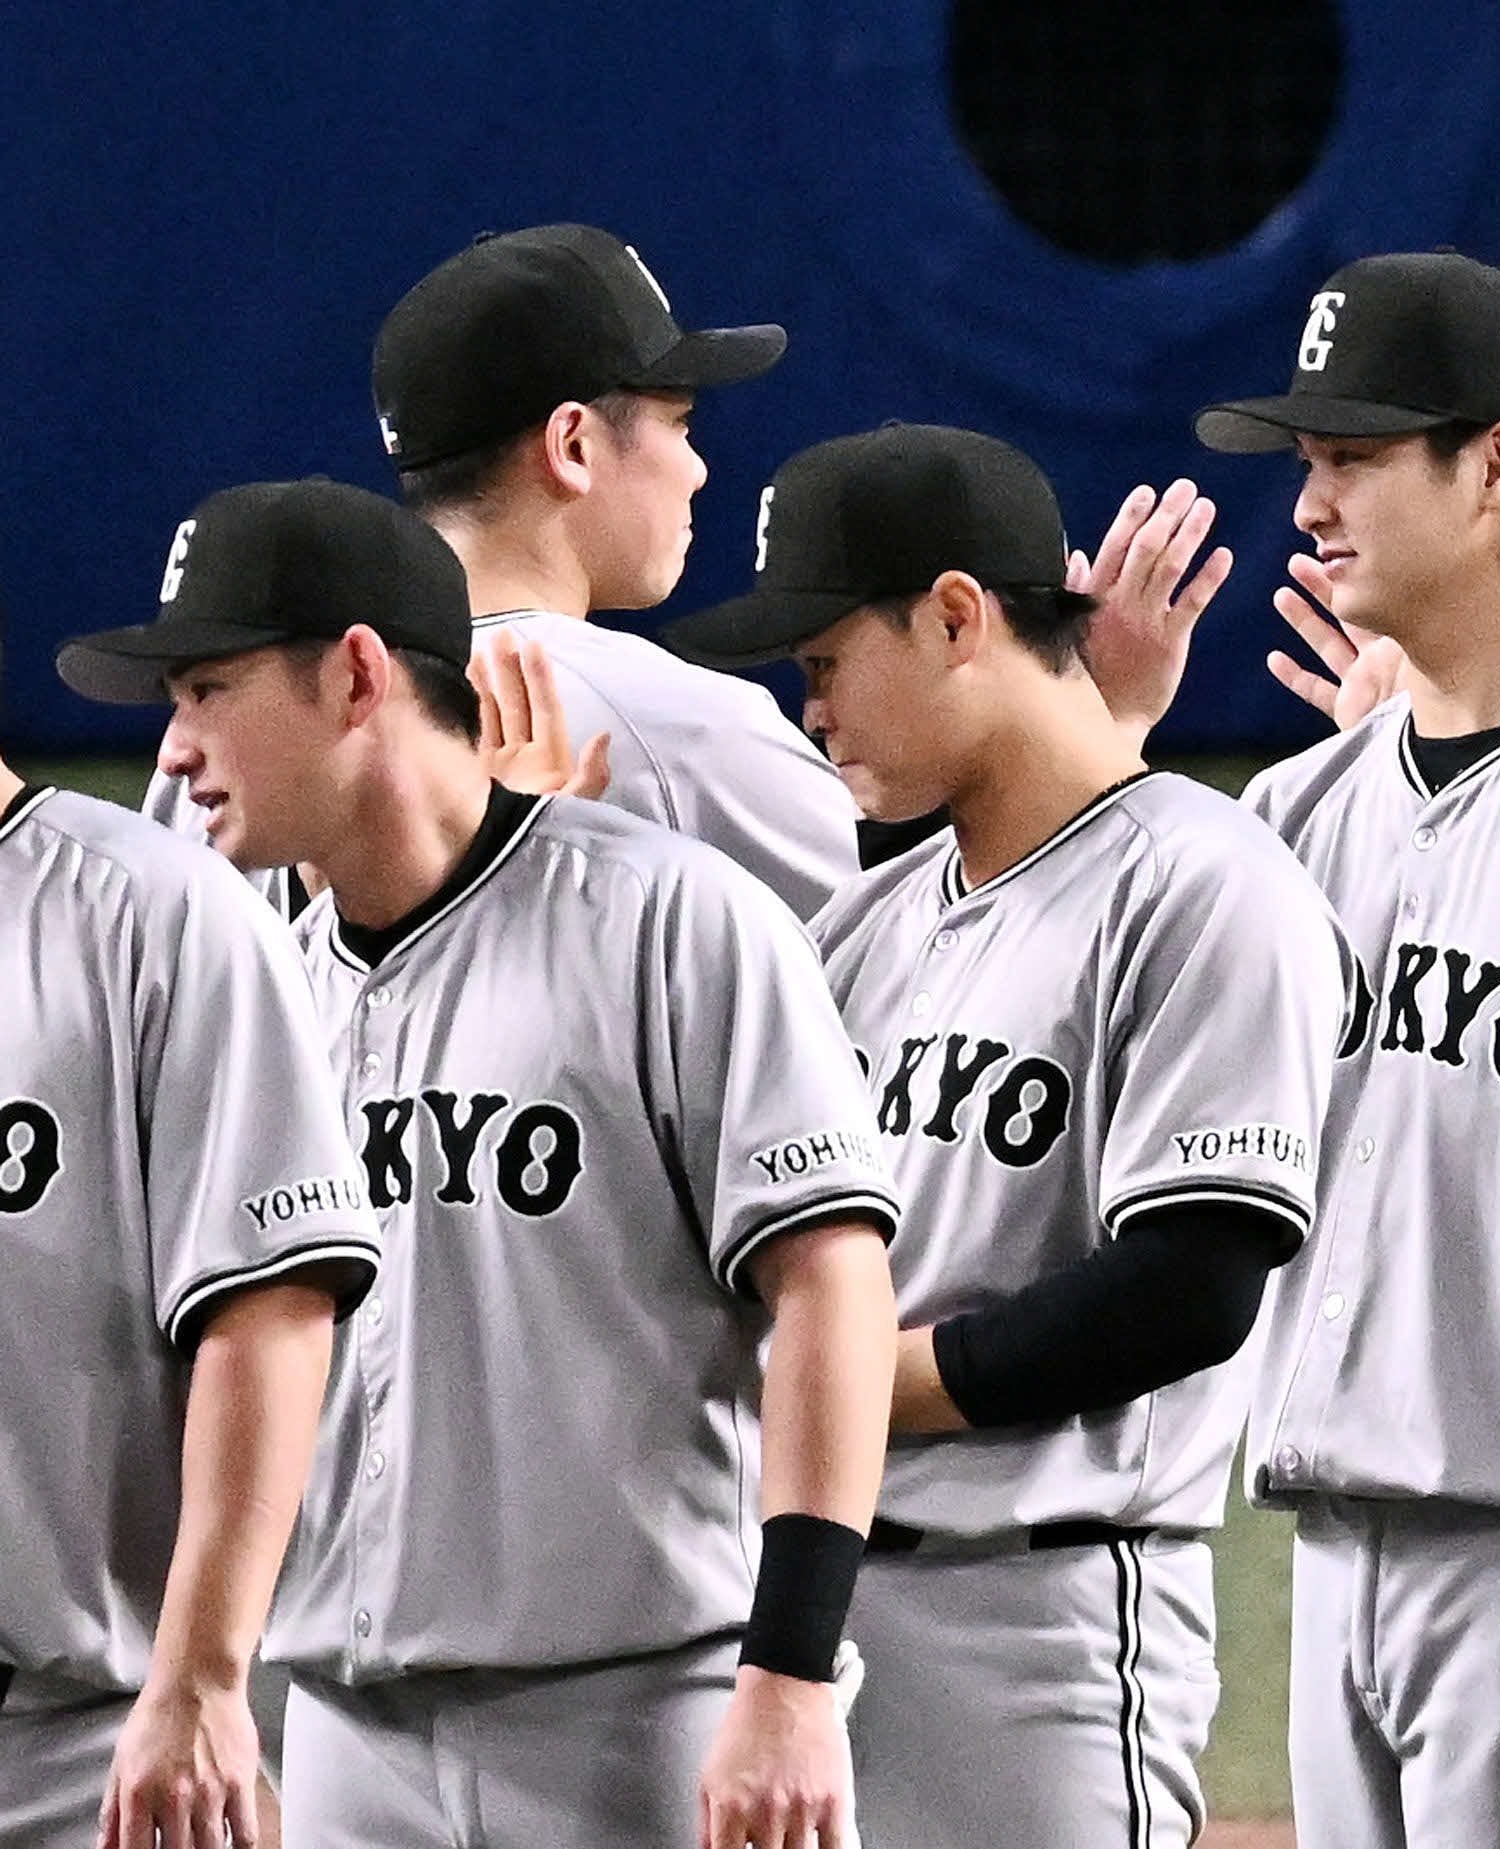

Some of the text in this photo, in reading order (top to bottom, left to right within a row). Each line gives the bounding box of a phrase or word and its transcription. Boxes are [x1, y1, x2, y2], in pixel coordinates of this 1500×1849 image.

[855, 1033, 1071, 1167] KYO
[360, 1089, 584, 1217] KYO
[754, 1131, 883, 1183] YOMI
[1174, 1127, 1315, 1176] YOMIUR
